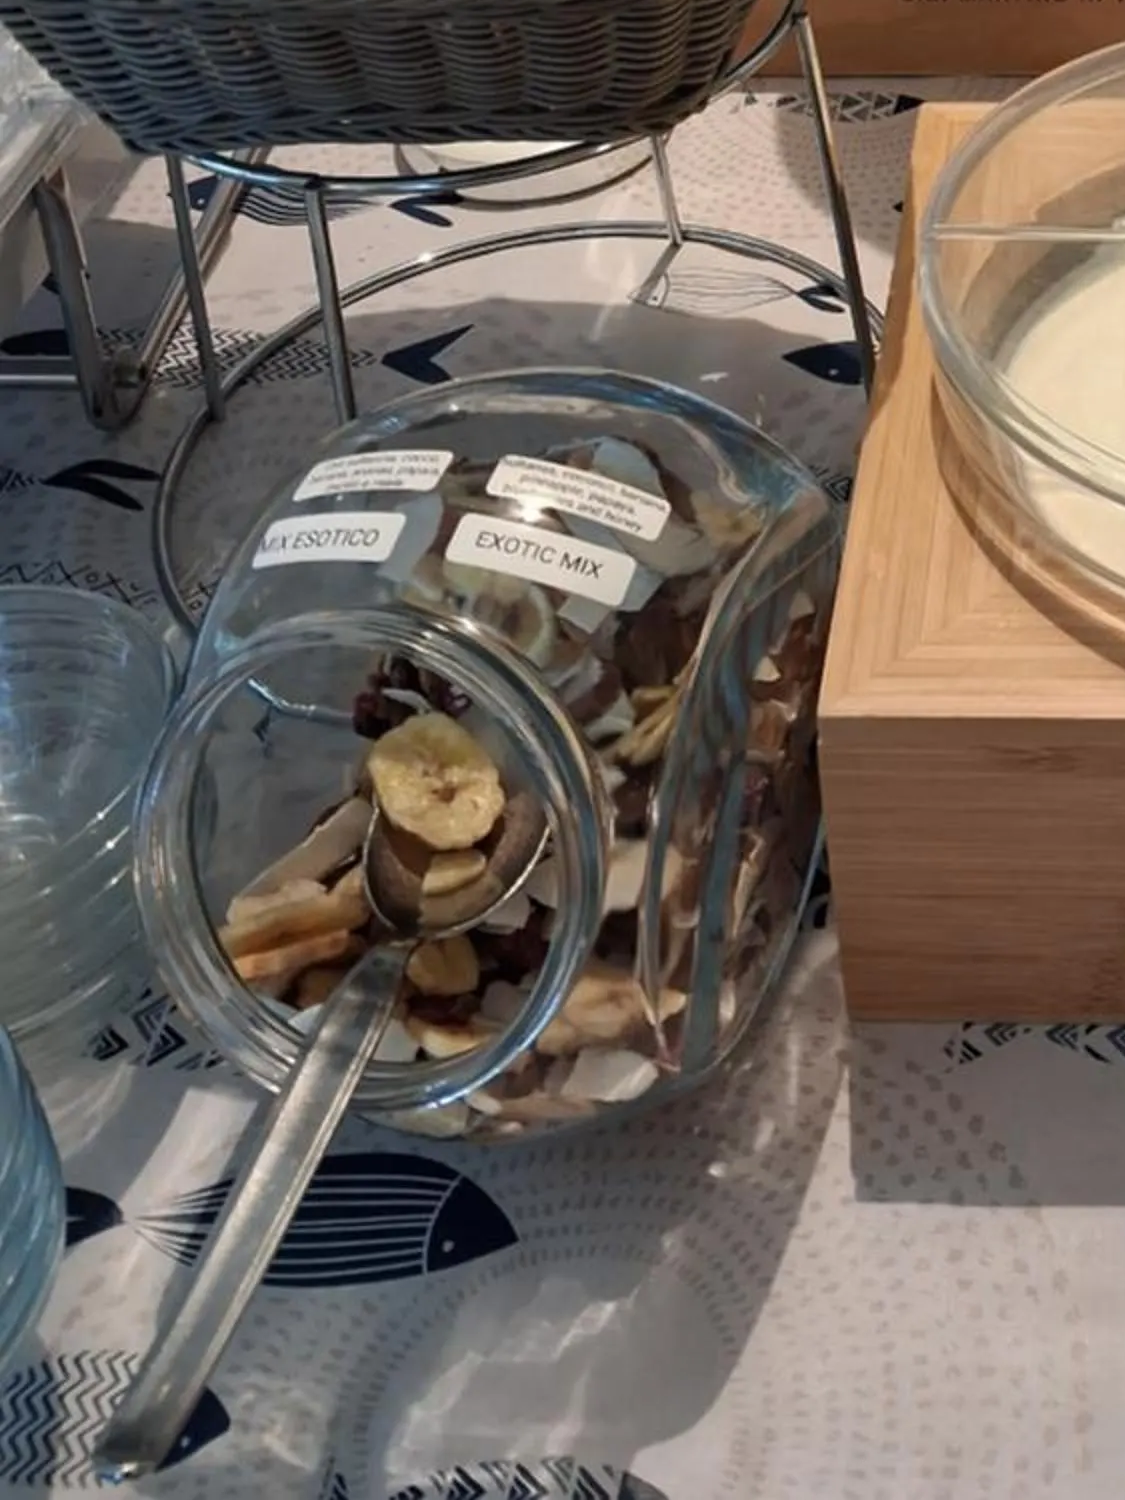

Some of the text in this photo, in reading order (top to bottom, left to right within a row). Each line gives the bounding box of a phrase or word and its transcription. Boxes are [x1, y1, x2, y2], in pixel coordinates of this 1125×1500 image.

[292, 528, 381, 549] ESOTICO
[475, 530, 604, 579] EXOTIC MIX
